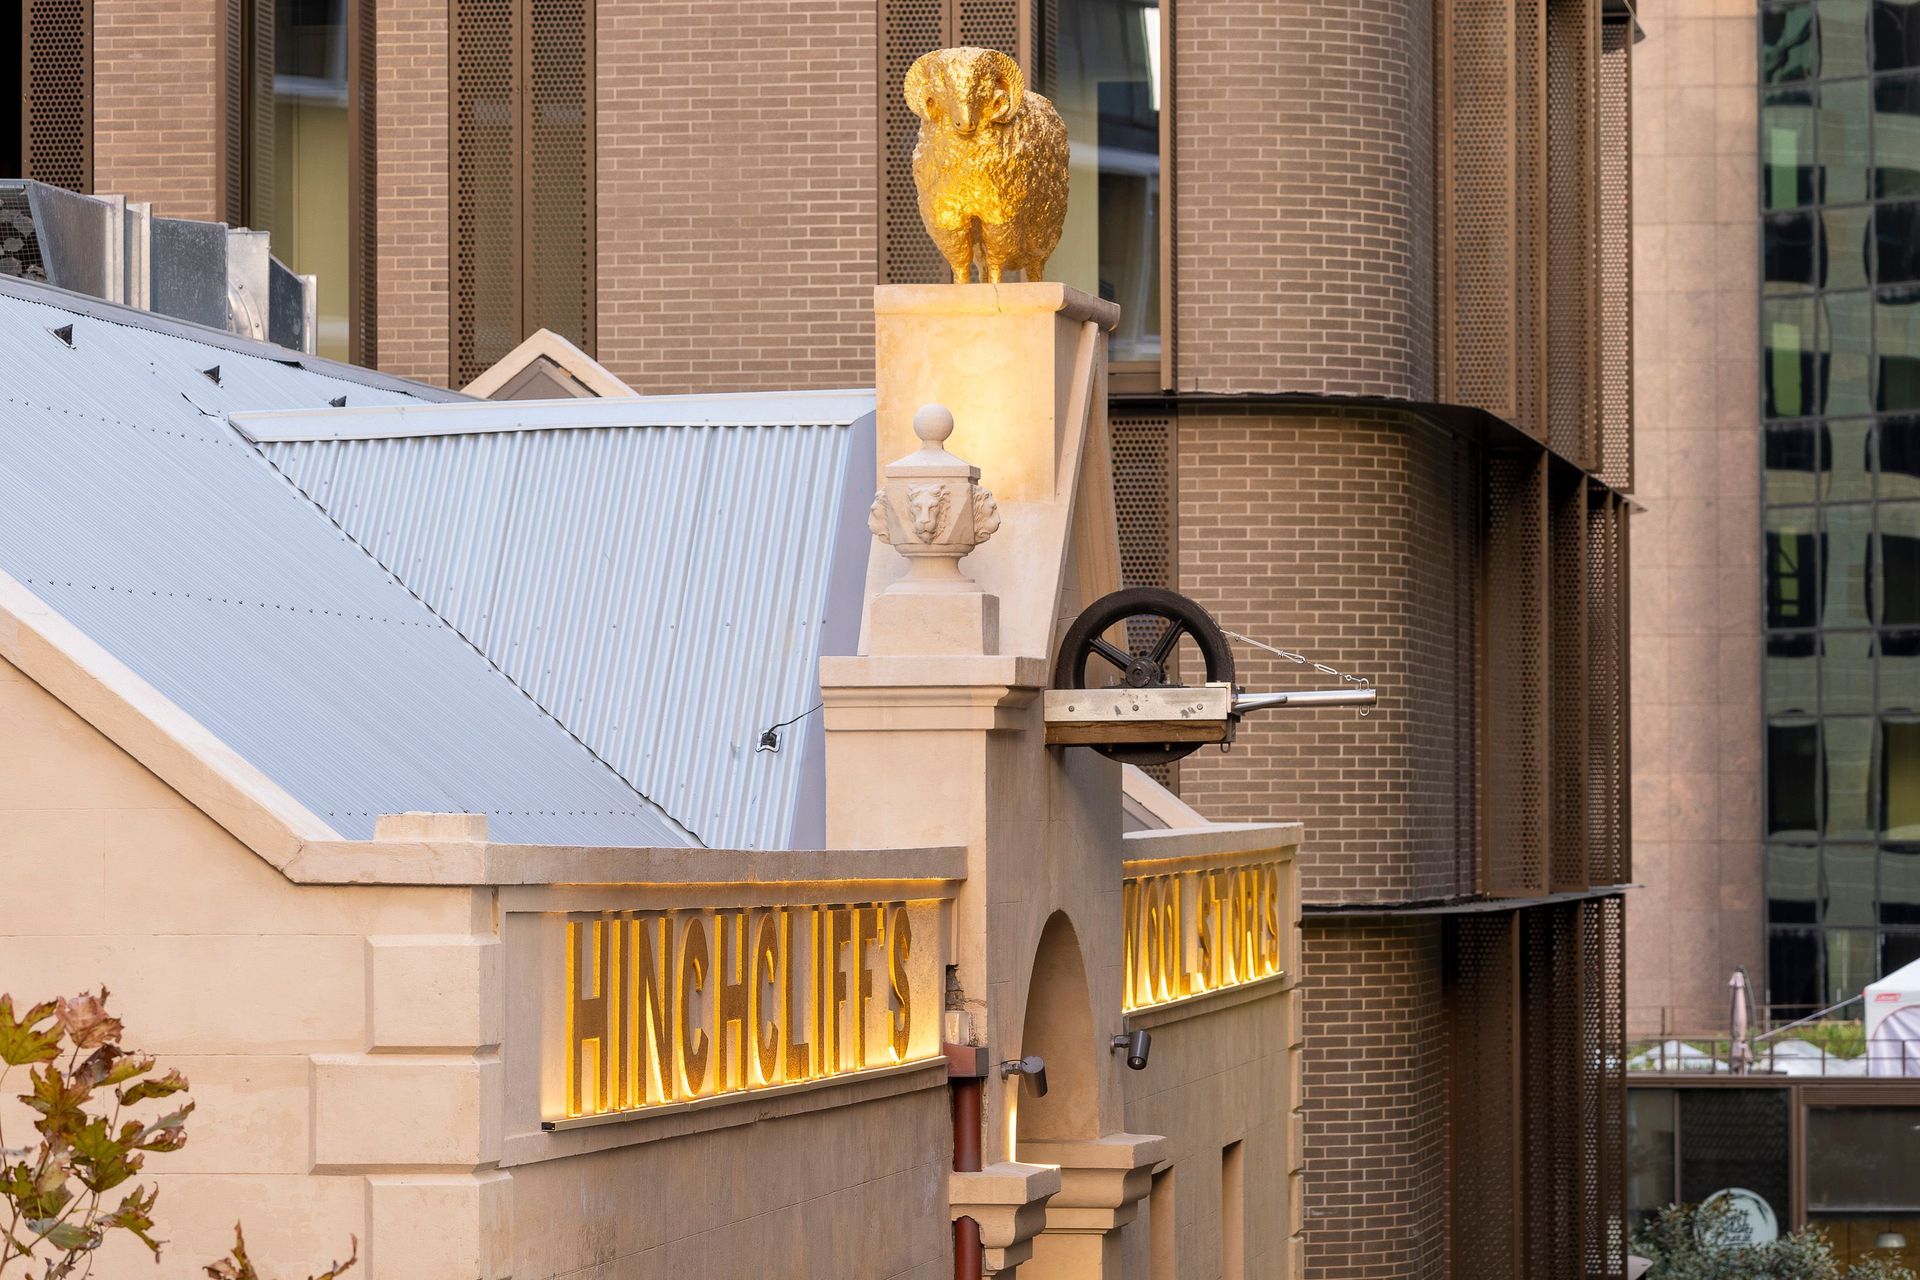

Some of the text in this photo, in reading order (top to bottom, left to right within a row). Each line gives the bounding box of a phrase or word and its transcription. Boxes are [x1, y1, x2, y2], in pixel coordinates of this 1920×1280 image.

[566, 906, 912, 1118] HINCHCLIFF'S
[1123, 866, 1280, 1011] WOOL STORES
